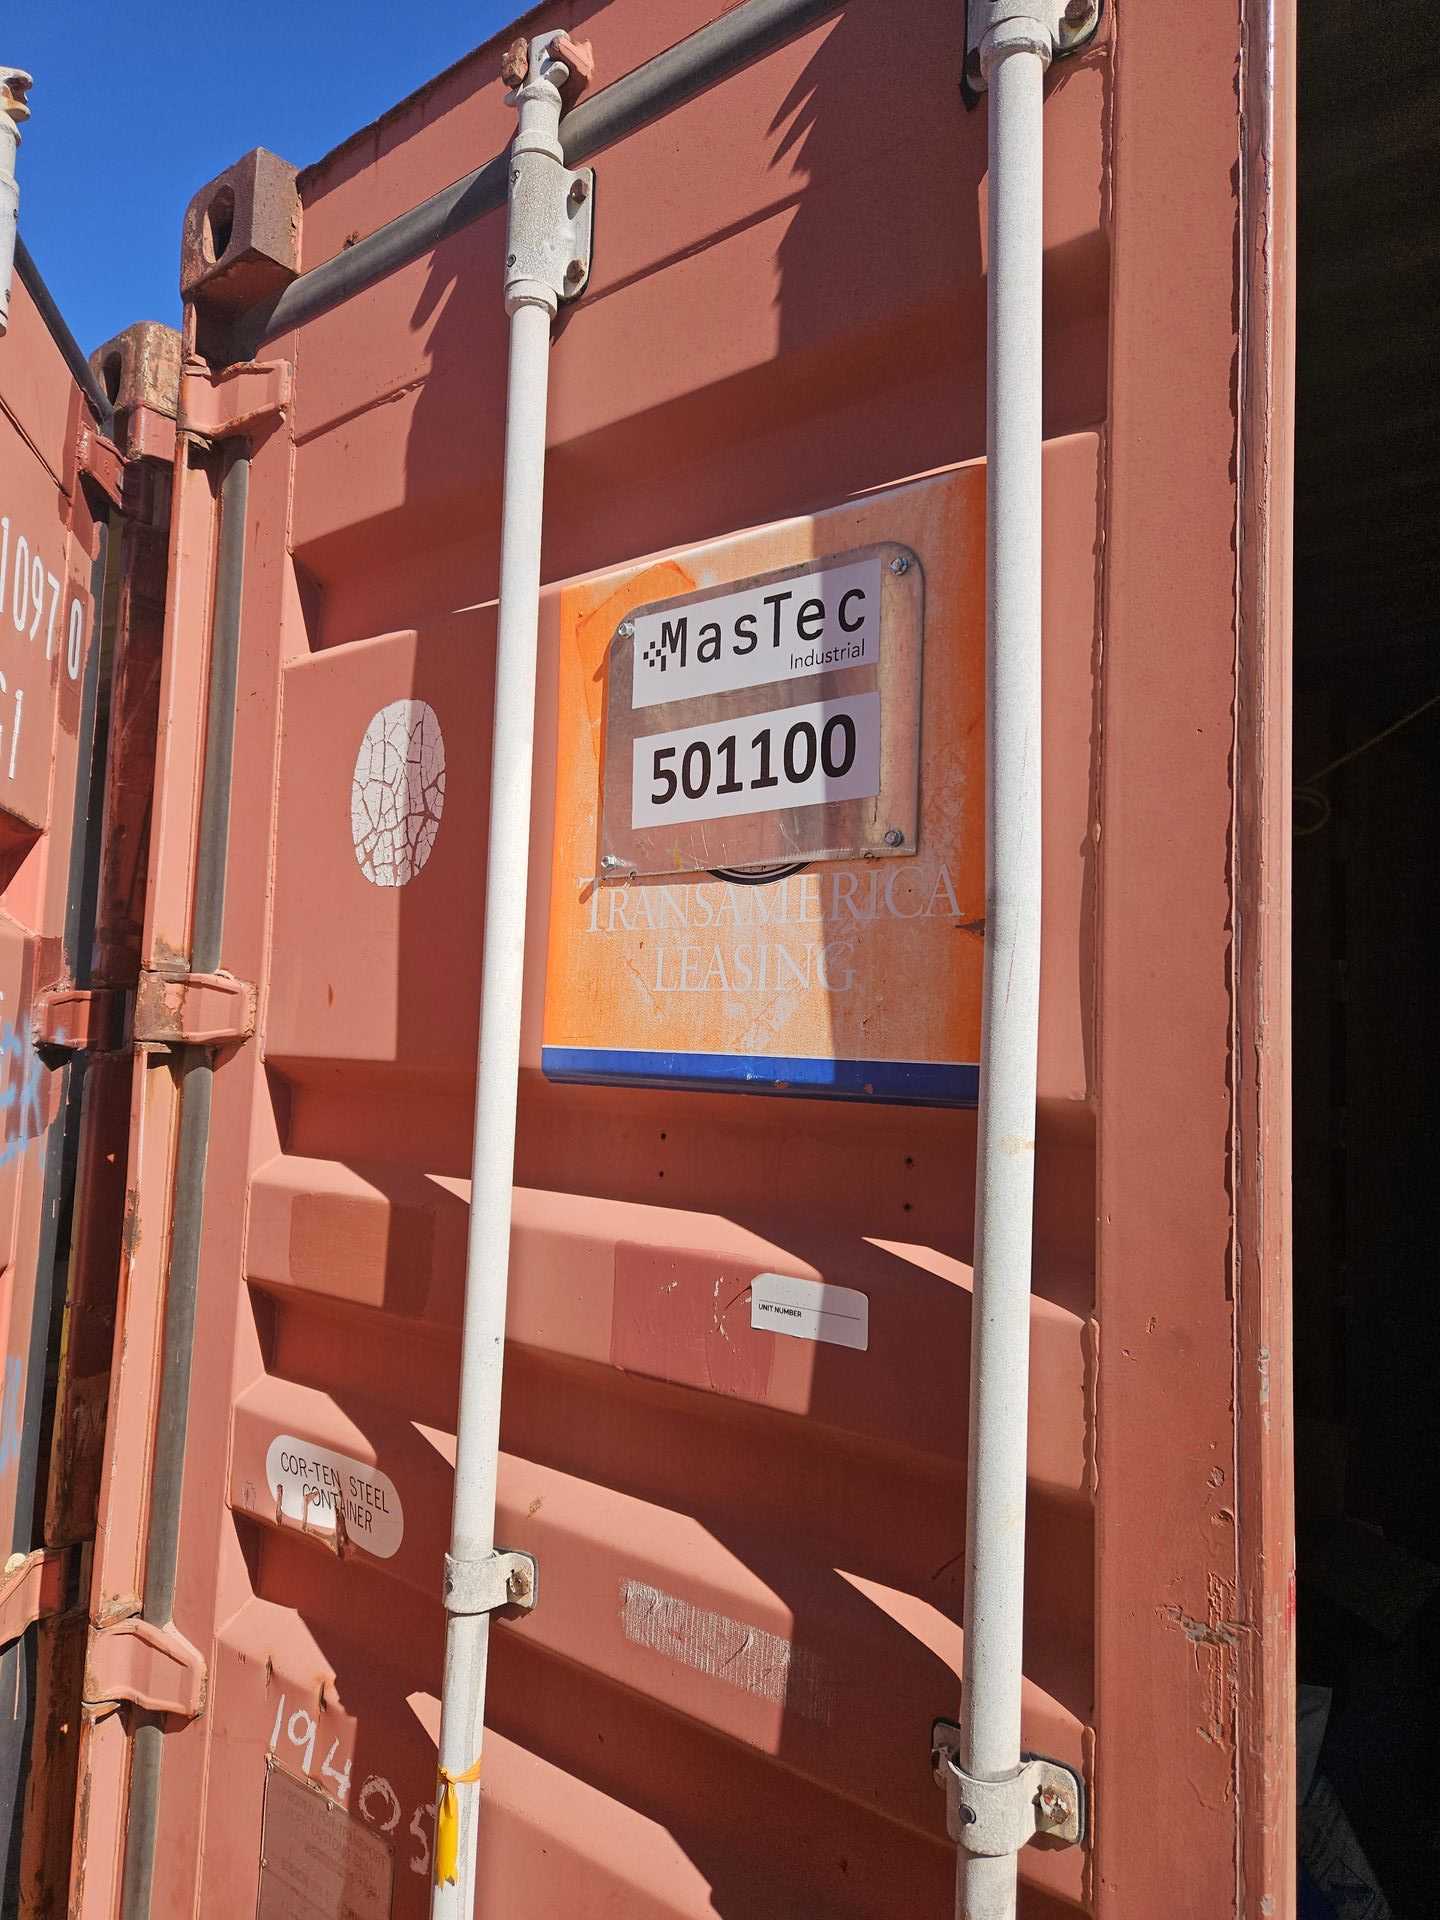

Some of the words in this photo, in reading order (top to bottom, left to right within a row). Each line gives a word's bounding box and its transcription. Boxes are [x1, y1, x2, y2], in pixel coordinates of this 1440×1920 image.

[660, 588, 867, 672] MasTec
[789, 638, 866, 671] Industrial
[651, 713, 857, 806] 501100
[576, 862, 966, 935] TRANSAMERICA
[652, 940, 859, 993] LEASING
[758, 1303, 774, 1313] UNIT
[774, 1305, 802, 1318] NUMBER
[280, 1451, 342, 1490] COR-TEN
[349, 1475, 390, 1514] STEEL
[302, 1482, 373, 1534] CONTAINER
